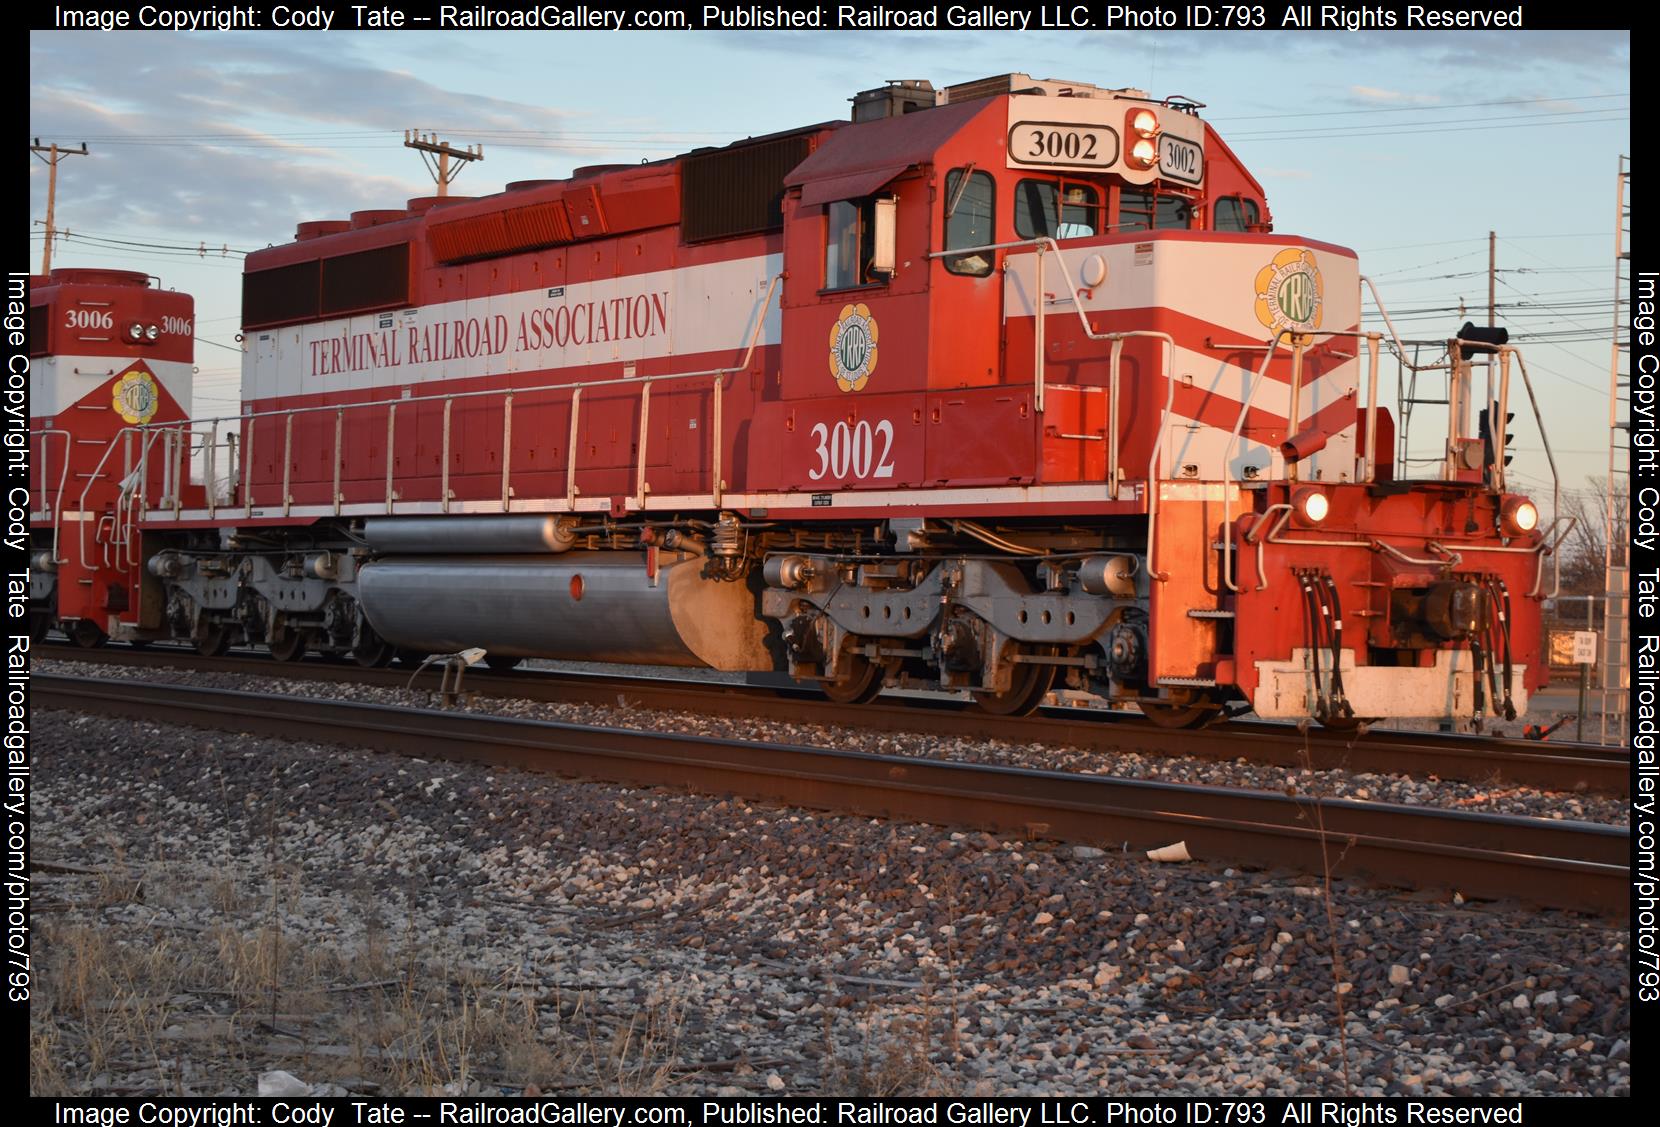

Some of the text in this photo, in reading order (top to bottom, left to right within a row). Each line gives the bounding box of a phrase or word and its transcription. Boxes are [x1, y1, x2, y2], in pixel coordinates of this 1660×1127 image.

[1029, 130, 1098, 160] 3002
[1166, 142, 1195, 174] 3002
[1268, 277, 1281, 315] TERMINAL
[1279, 273, 1313, 321] TRRA
[65, 310, 113, 329] 3006
[160, 316, 192, 336] 3006
[310, 291, 669, 376] TERMINAL RAILROAD ASSOCIATION
[841, 326, 865, 369] TRRA
[808, 420, 895, 480] 3002
